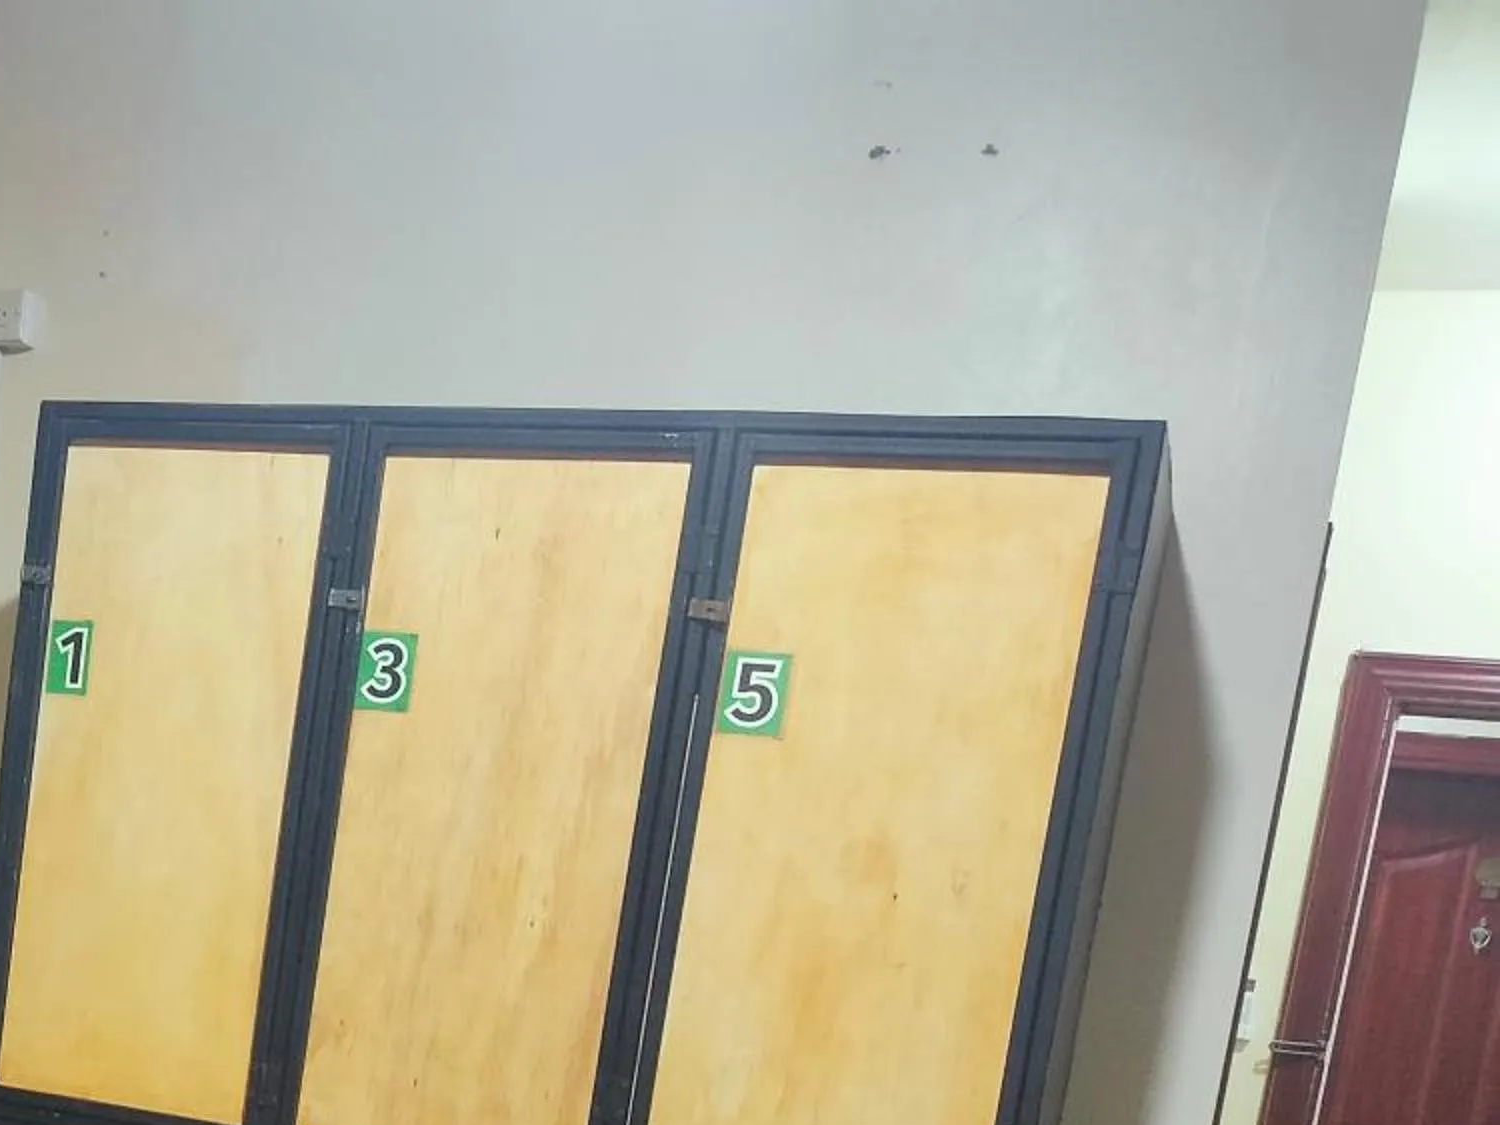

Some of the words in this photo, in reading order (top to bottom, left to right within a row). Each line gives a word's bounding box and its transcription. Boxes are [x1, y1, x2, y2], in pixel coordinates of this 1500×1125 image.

[56, 627, 88, 688] 1
[361, 638, 408, 703] 3
[724, 656, 784, 728] 5
